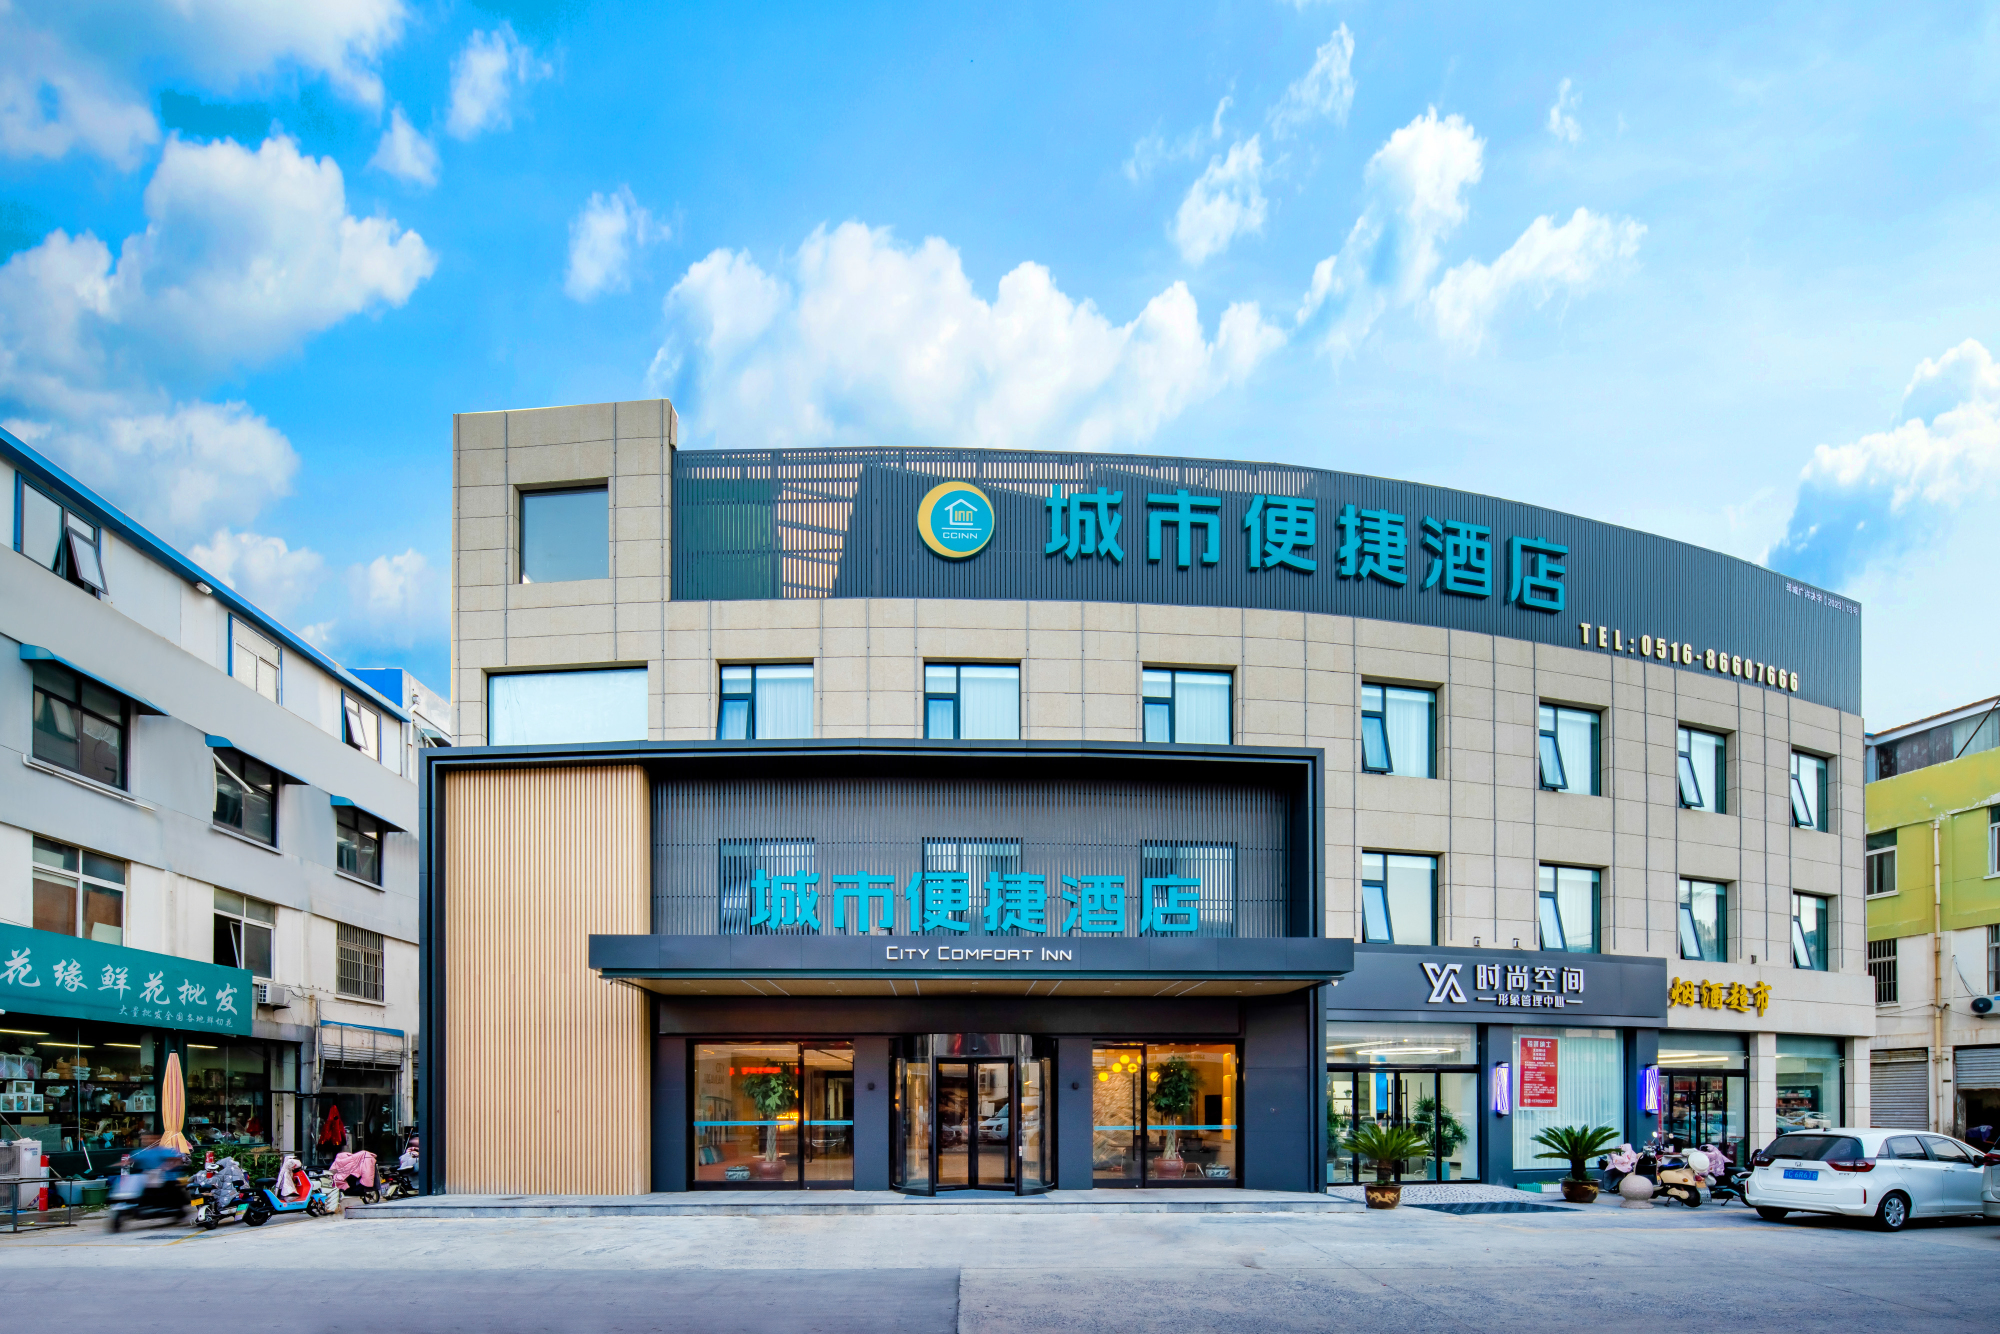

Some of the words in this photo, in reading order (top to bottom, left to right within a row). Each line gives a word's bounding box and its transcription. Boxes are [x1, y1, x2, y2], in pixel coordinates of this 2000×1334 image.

[942, 532, 978, 540] CCINN
[1045, 484, 1569, 613] 城市便捷酒店
[750, 868, 1202, 932] 城市便捷酒店
[886, 946, 930, 960] CITY
[937, 946, 1034, 961] COMFORT
[1041, 946, 1073, 961] INN
[0, 946, 238, 1016] 花缘鲜花批发
[1475, 963, 1585, 993] 时尚空间
[1497, 993, 1566, 1008] 形象管理中心
[1667, 976, 1773, 1017] 烟酒超市
